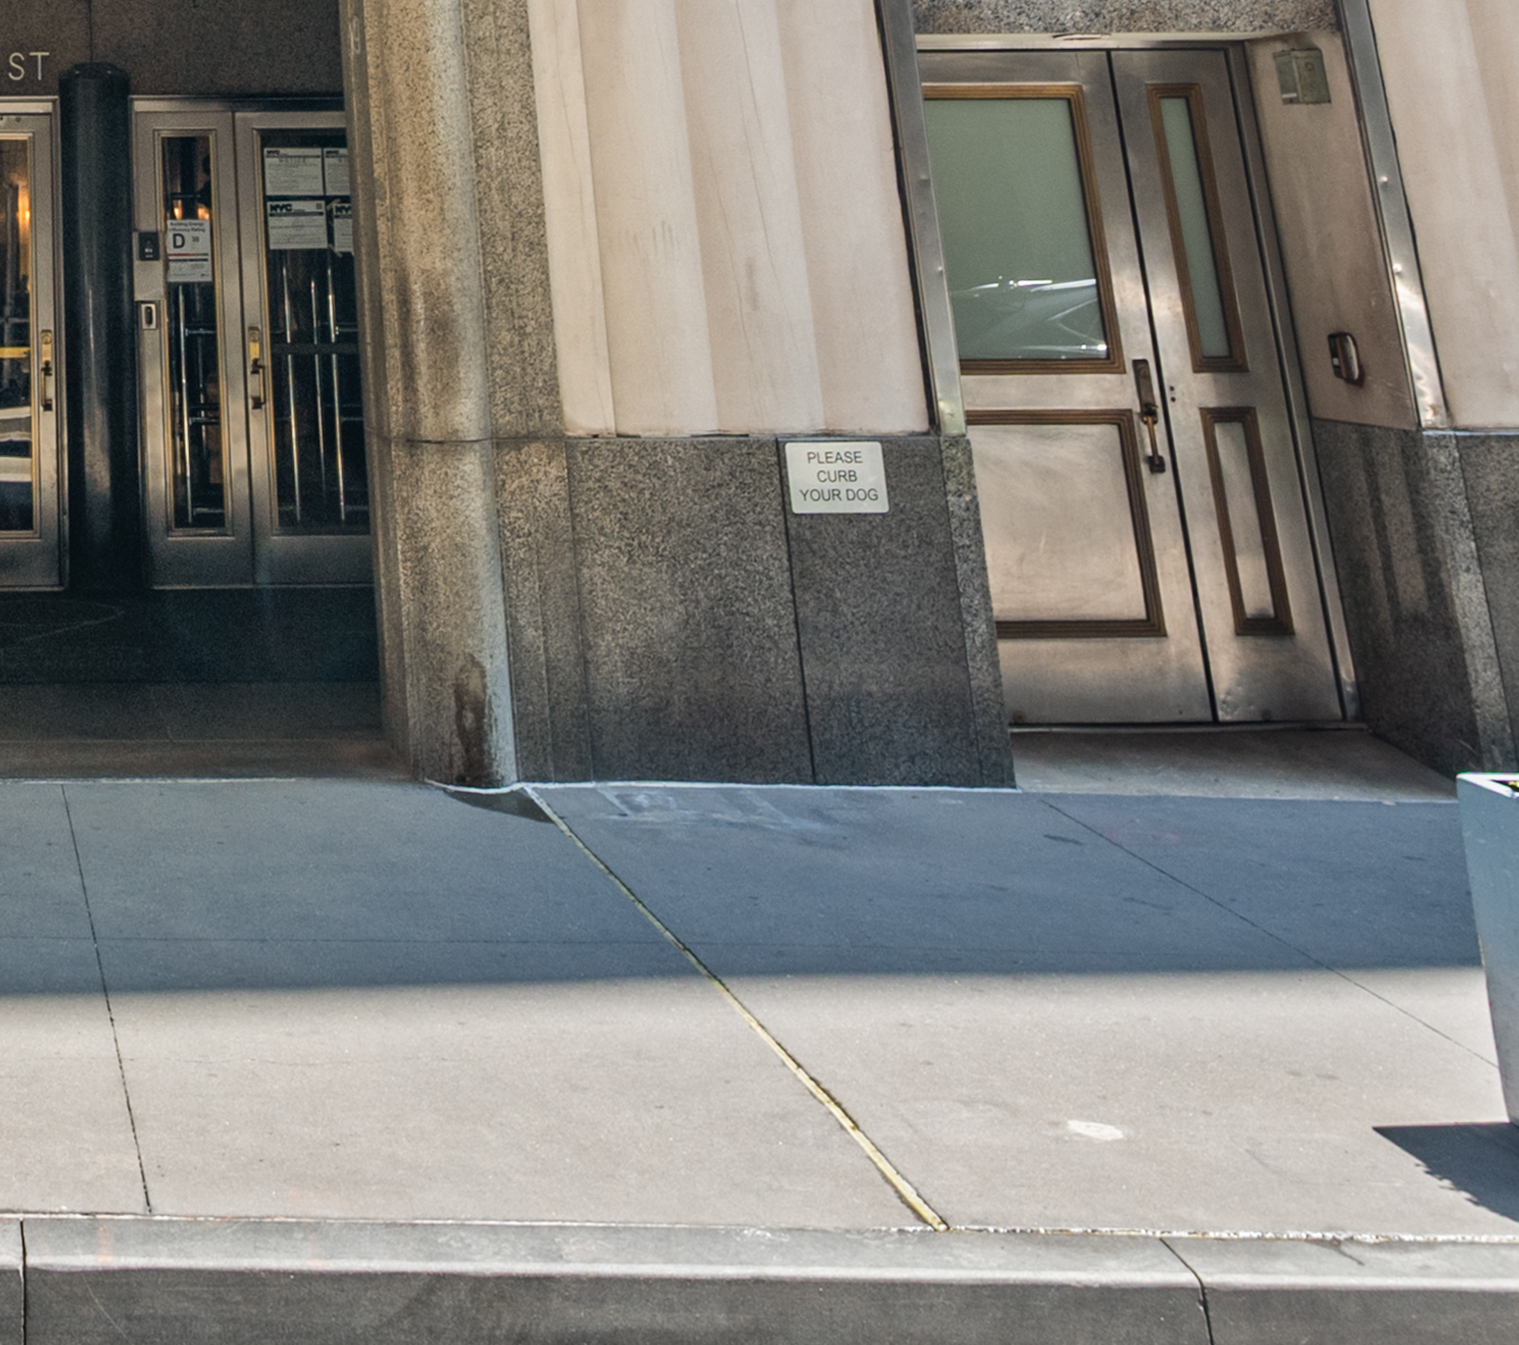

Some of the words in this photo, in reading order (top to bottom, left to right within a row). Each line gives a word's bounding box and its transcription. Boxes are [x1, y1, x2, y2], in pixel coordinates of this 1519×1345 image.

[8, 52, 50, 80] ST
[173, 233, 185, 249] D
[807, 451, 863, 464] PLEASE
[817, 470, 858, 483] CURB
[799, 488, 842, 502] YOUR
[846, 488, 879, 501] DOG
